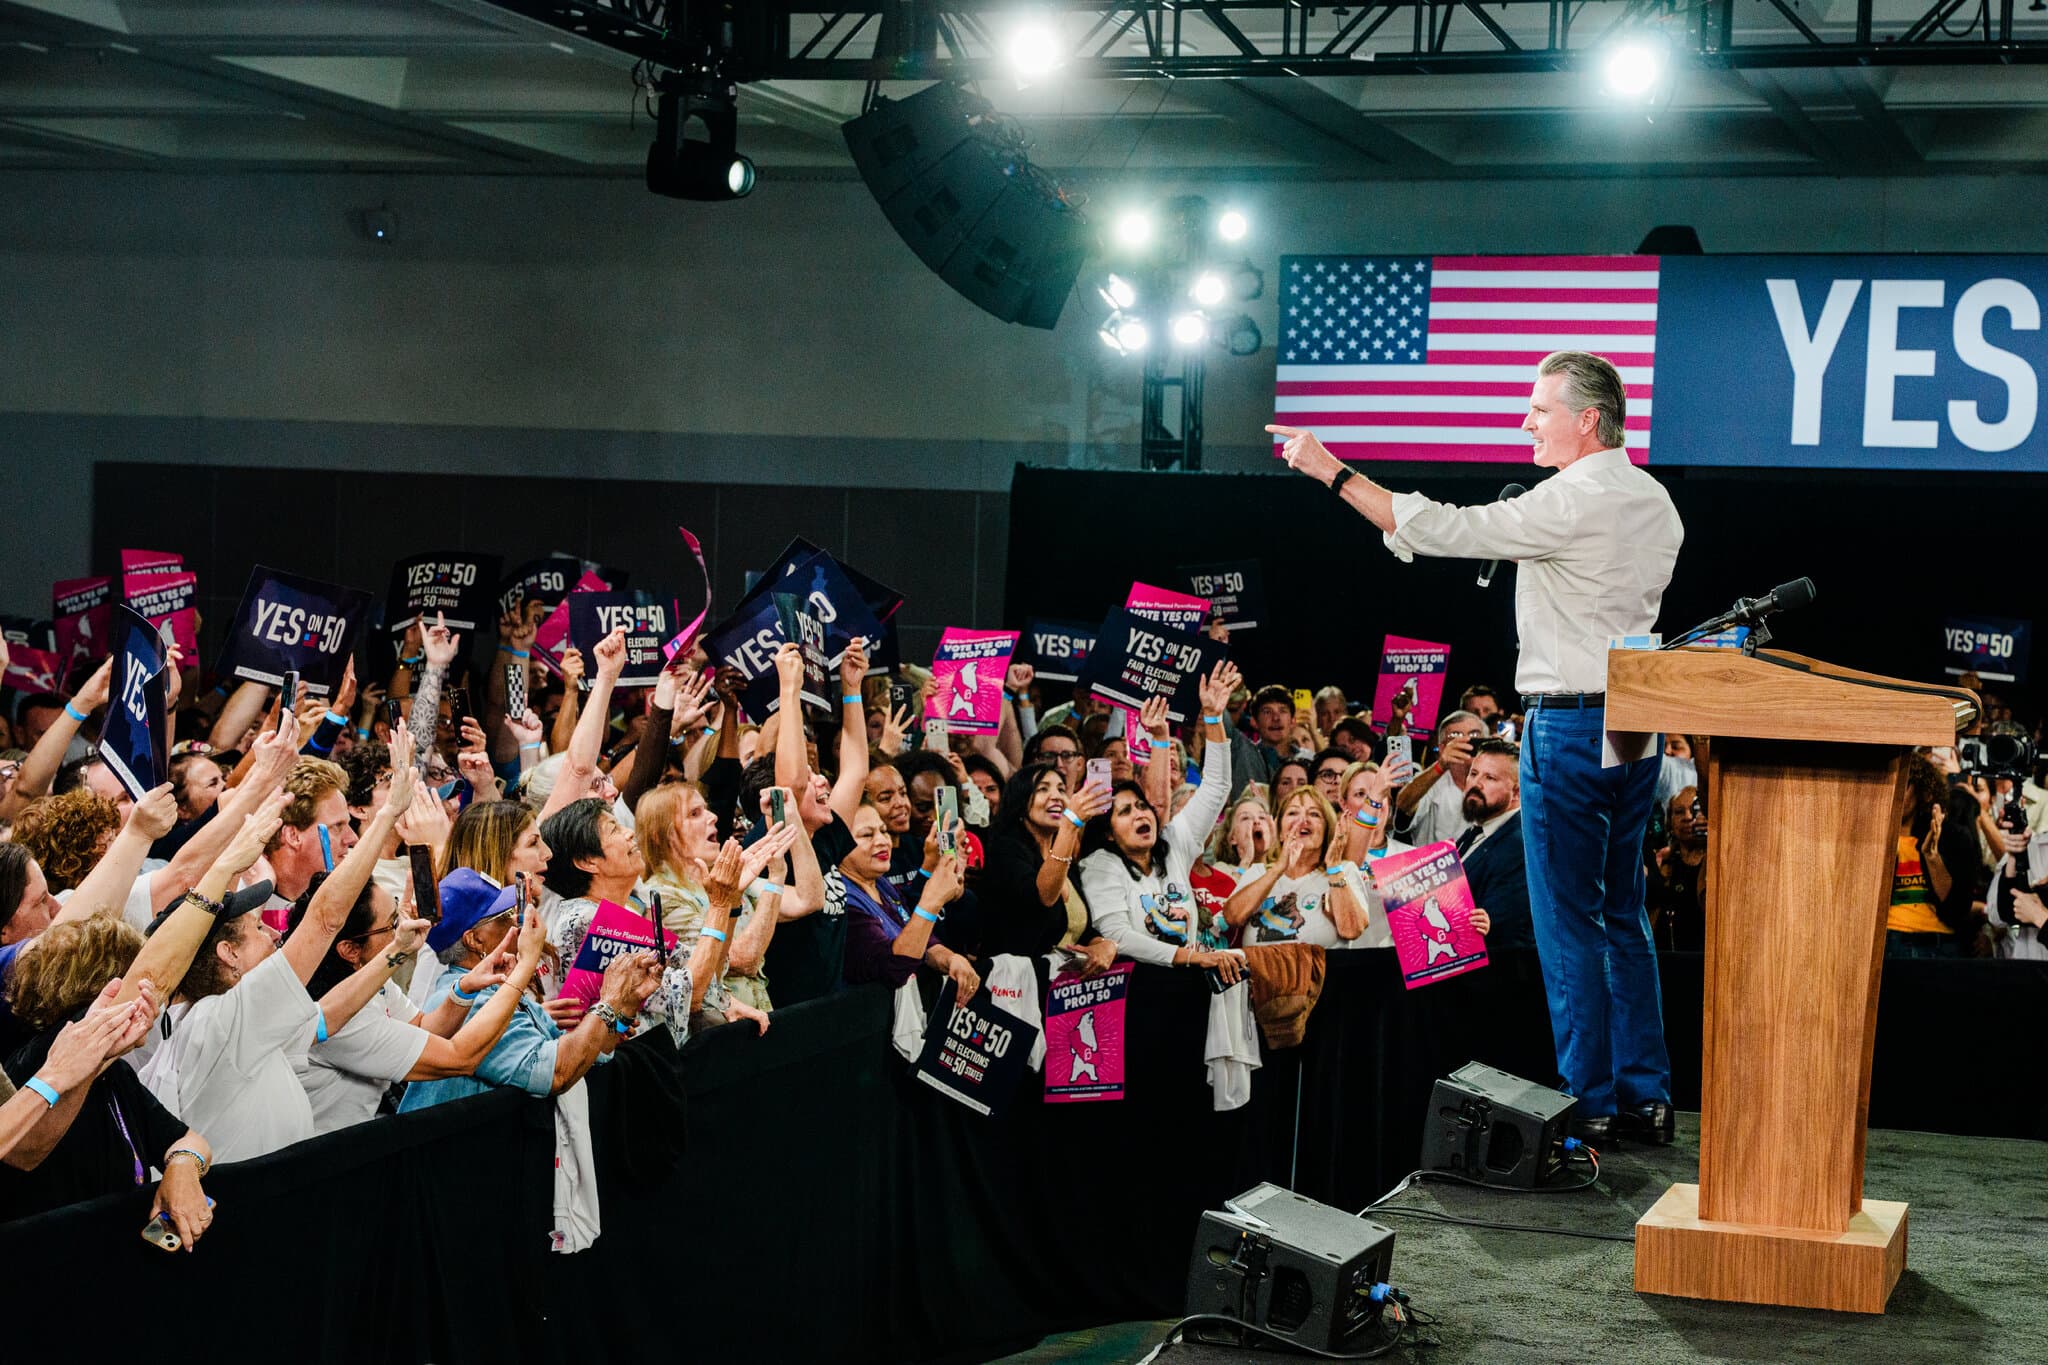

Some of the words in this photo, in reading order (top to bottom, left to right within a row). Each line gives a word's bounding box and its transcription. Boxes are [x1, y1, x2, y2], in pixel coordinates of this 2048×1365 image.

[1766, 278, 2041, 452] YES
[407, 562, 437, 588] YES
[438, 562, 451, 574] ON
[451, 562, 477, 587] 50
[1191, 575, 1214, 596] YES
[1224, 571, 1245, 593] 50
[130, 593, 159, 609] VOTE
[160, 588, 180, 601] YES
[179, 584, 194, 597] ON
[422, 595, 437, 608] 50
[437, 598, 458, 608] STATES
[423, 586, 461, 597] ELECTIONS
[499, 581, 525, 613] YES
[525, 575, 538, 587] ON
[540, 571, 565, 591] 50
[142, 601, 171, 617] PROP
[596, 605, 635, 634] YES
[636, 607, 648, 620] ON
[647, 604, 666, 633] 50
[1162, 610, 1182, 622] YES
[1183, 610, 1201, 623] ON
[253, 598, 306, 646] YES
[307, 614, 324, 633] ON
[319, 616, 347, 654] 50
[627, 636, 659, 649] ELECTIONS
[724, 628, 783, 681] YES
[943, 643, 972, 654] VOTE
[974, 641, 994, 650] YES
[994, 639, 1013, 648] ON
[951, 649, 982, 660] PROP
[1034, 633, 1071, 658] YES
[1073, 637, 1087, 650] ON
[1125, 627, 1166, 663] YES
[1166, 641, 1180, 657] ON
[1175, 644, 1203, 674] 50
[1945, 627, 1975, 653] YES
[1976, 632, 1990, 645] ON
[1989, 633, 2014, 658] 50
[630, 648, 644, 665] 50
[1386, 654, 1411, 664] VOTE
[1412, 654, 1429, 664] YES
[1430, 653, 1445, 663] ON
[1394, 664, 1420, 673] PROP
[1421, 663, 1434, 673] 50
[1126, 658, 1146, 673] FAIR
[1145, 664, 1182, 684] ELECTIONS
[1129, 674, 1142, 685] ALL
[1141, 676, 1158, 694] 50
[1157, 683, 1177, 696] STATES
[1386, 873, 1416, 895] VOTE
[1417, 862, 1437, 880] YES
[1437, 853, 1456, 869] ON
[1401, 881, 1431, 903] PROP
[1432, 871, 1448, 887] 50
[591, 936, 628, 955] VOTE
[596, 925, 613, 936] Fight
[613, 929, 622, 937] for
[622, 931, 645, 942] Planned
[1053, 983, 1083, 1000] VOTE
[1084, 979, 1105, 995] YES
[1107, 974, 1125, 987] ON
[1064, 994, 1094, 1011] PROP
[1096, 989, 1111, 1002] 50
[946, 1002, 977, 1039] YES
[976, 1018, 991, 1035] ON
[984, 1023, 1012, 1058] 50
[944, 1036, 960, 1049] FAIR
[957, 1043, 990, 1069] ELECTIONS
[945, 1054, 954, 1067] ALL
[952, 1057, 967, 1076] 50
[964, 1065, 984, 1082] STATES
